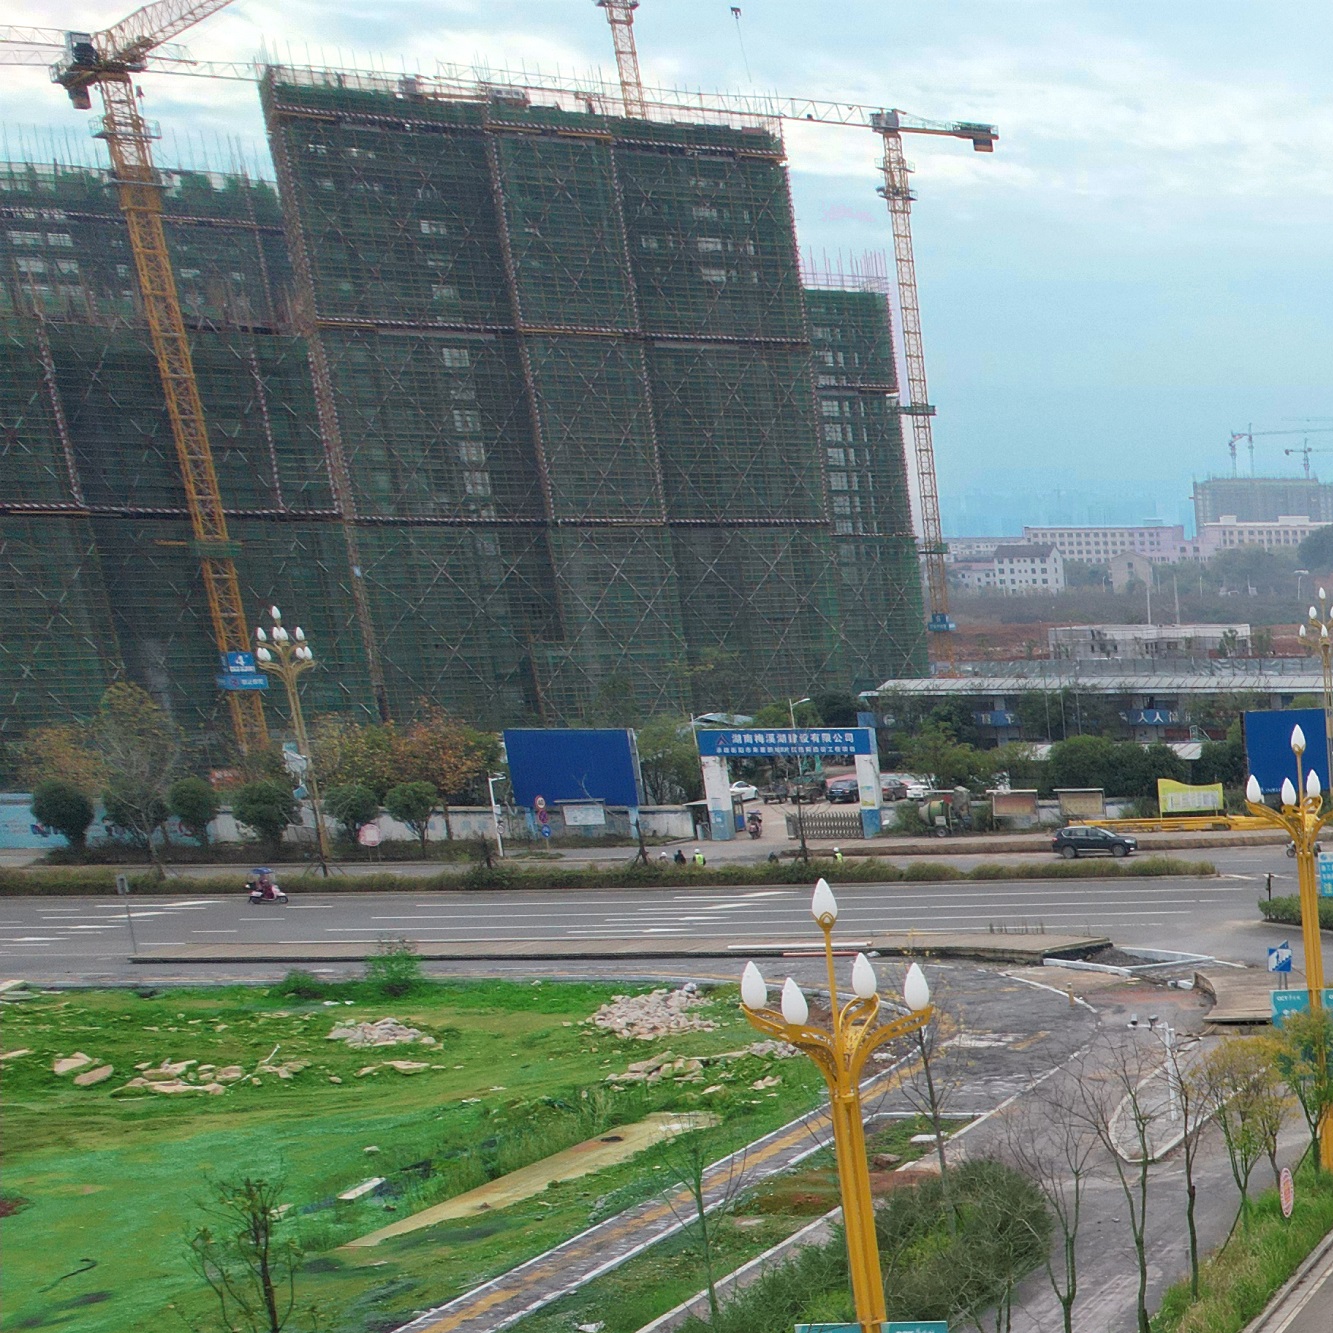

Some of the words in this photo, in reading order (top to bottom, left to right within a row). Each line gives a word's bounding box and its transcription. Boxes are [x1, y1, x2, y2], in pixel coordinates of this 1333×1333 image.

[732, 733, 854, 744] 湖南梅溪湖建设有限公司
